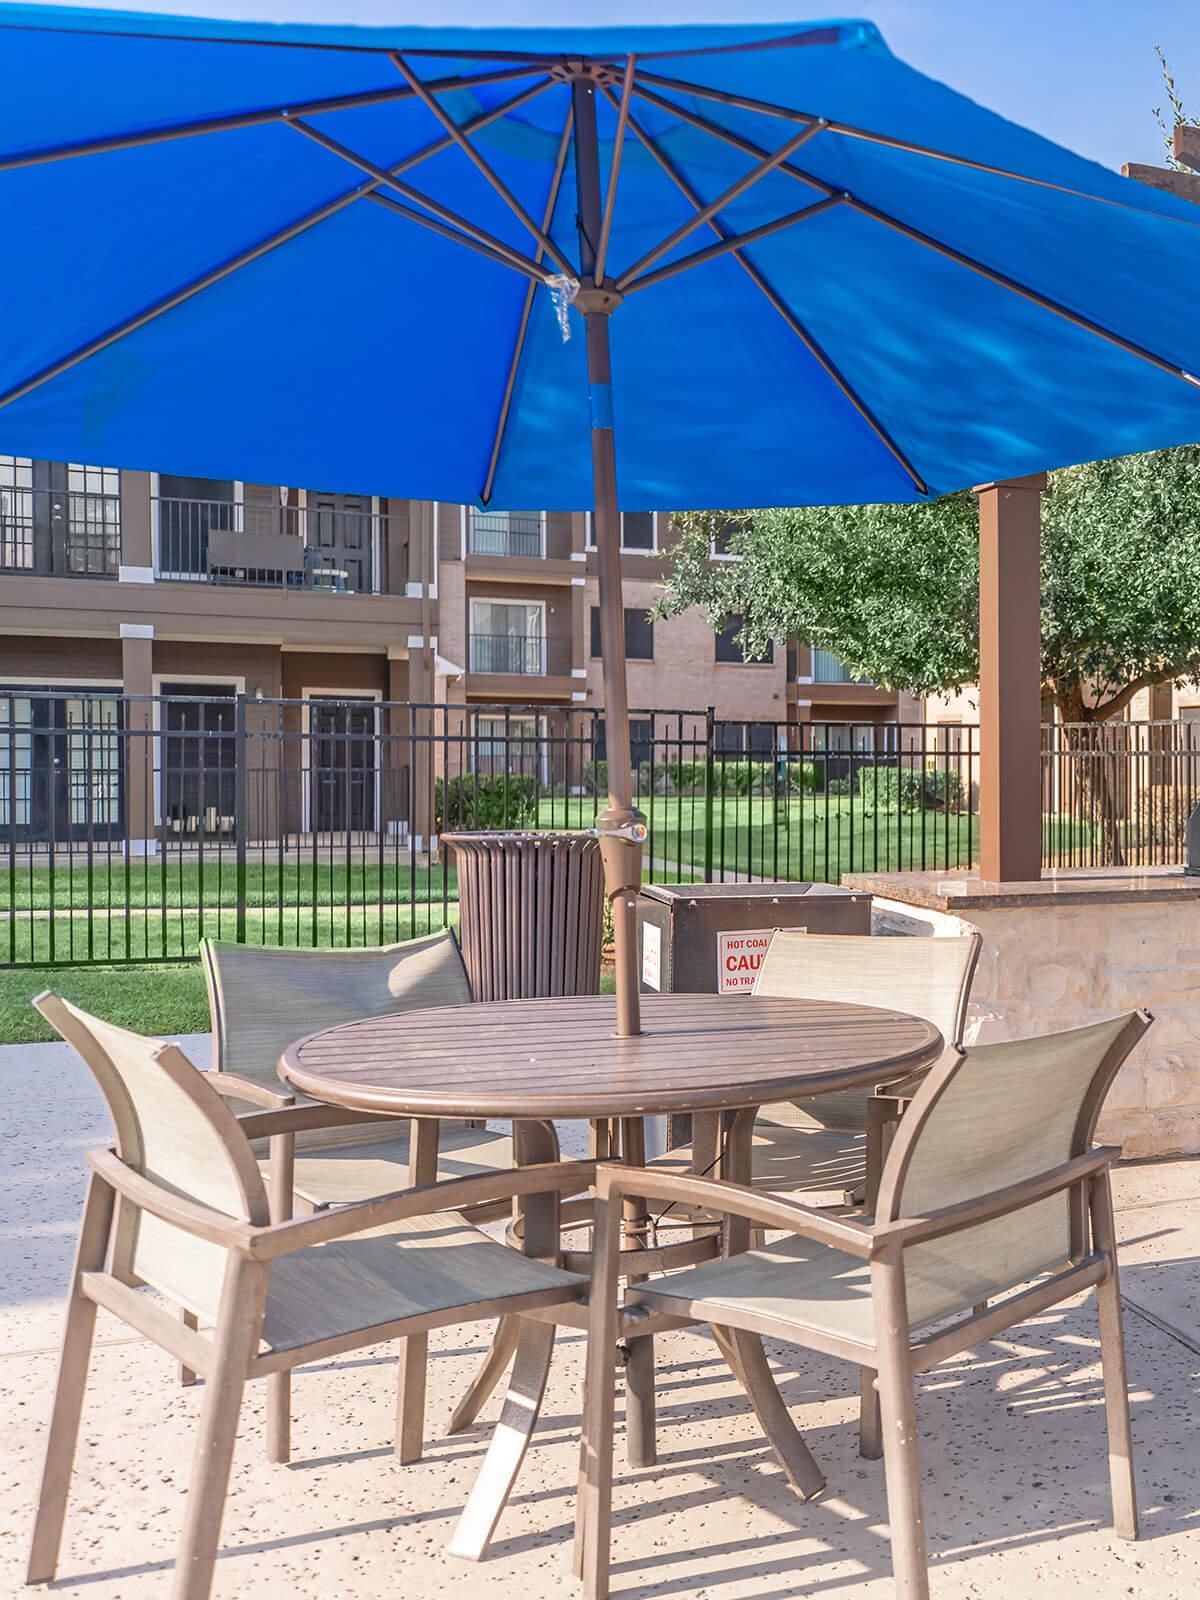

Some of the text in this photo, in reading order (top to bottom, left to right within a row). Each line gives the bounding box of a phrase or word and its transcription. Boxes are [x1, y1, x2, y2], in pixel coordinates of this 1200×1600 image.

[727, 940, 745, 949] HOT
[726, 954, 764, 971] CAU
[726, 978, 738, 986] NO
